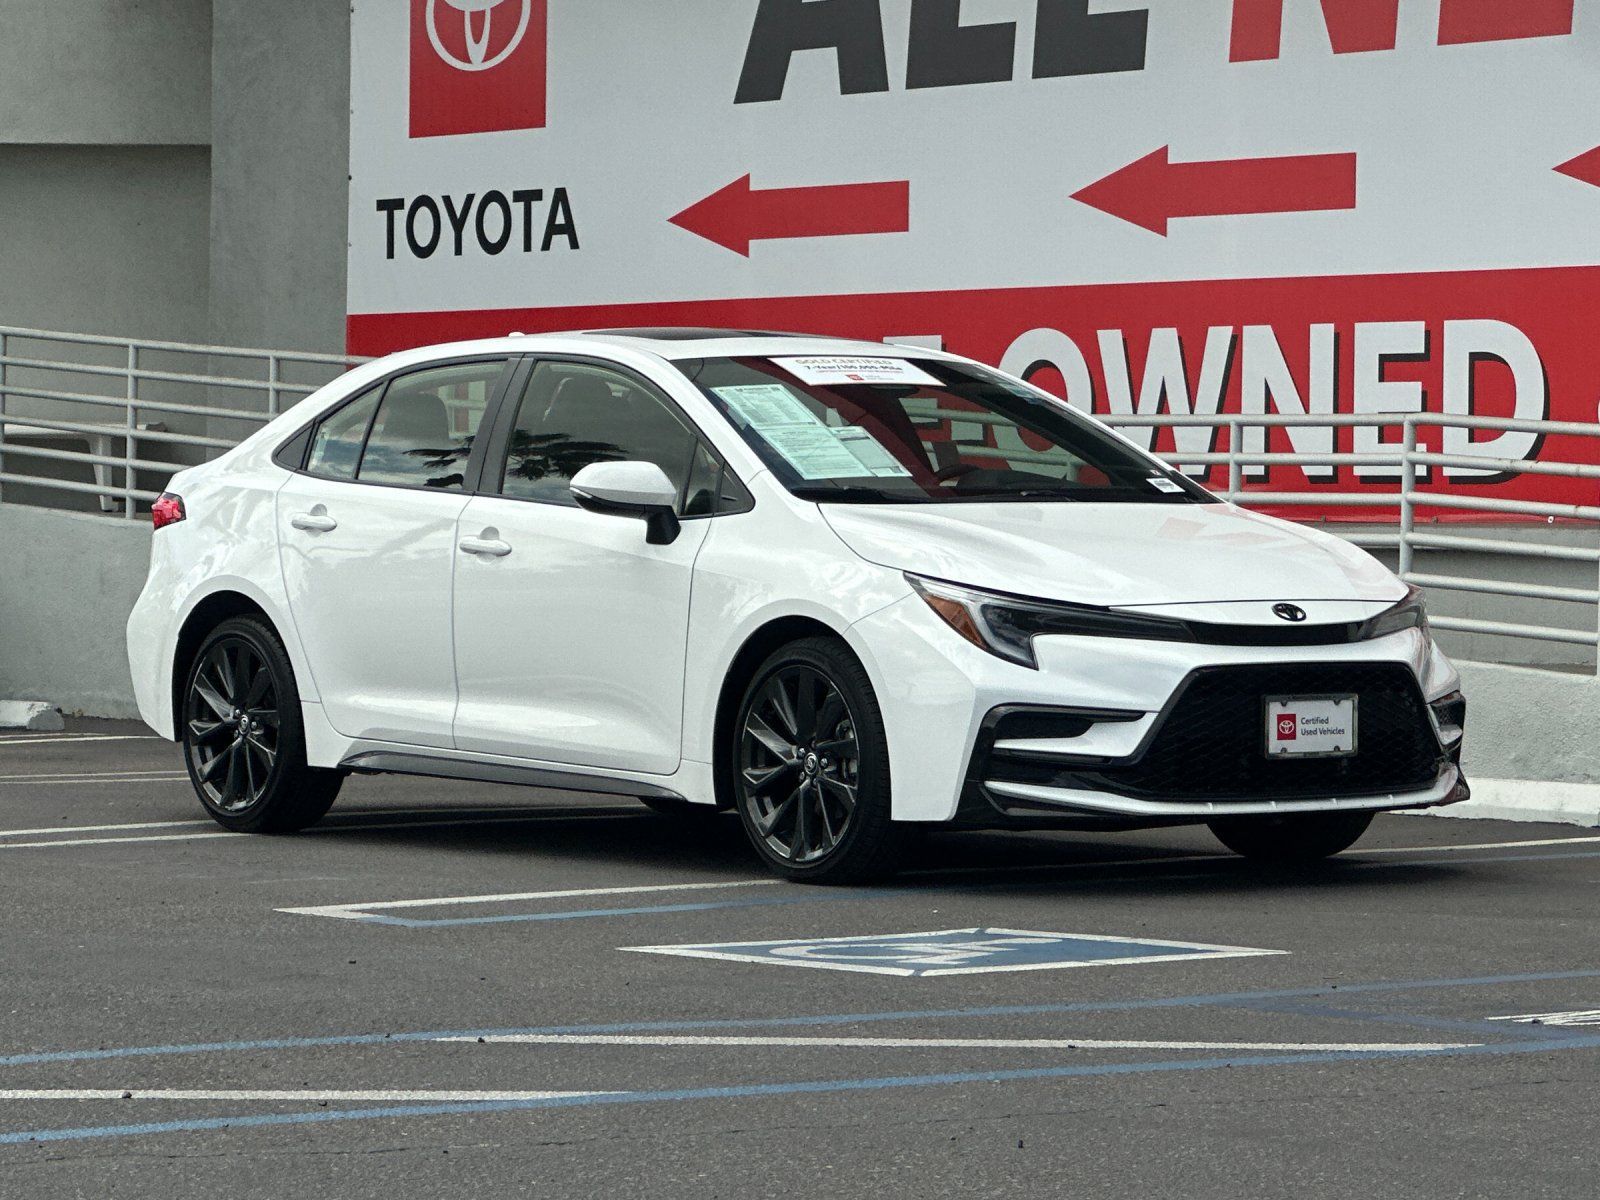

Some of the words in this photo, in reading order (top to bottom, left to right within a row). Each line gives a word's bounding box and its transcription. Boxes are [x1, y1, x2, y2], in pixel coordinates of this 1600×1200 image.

[376, 187, 580, 260] TOYOTA
[1300, 716, 1329, 725] Certified
[1300, 728, 1318, 736] Used
[1318, 727, 1345, 735] Vehicles
